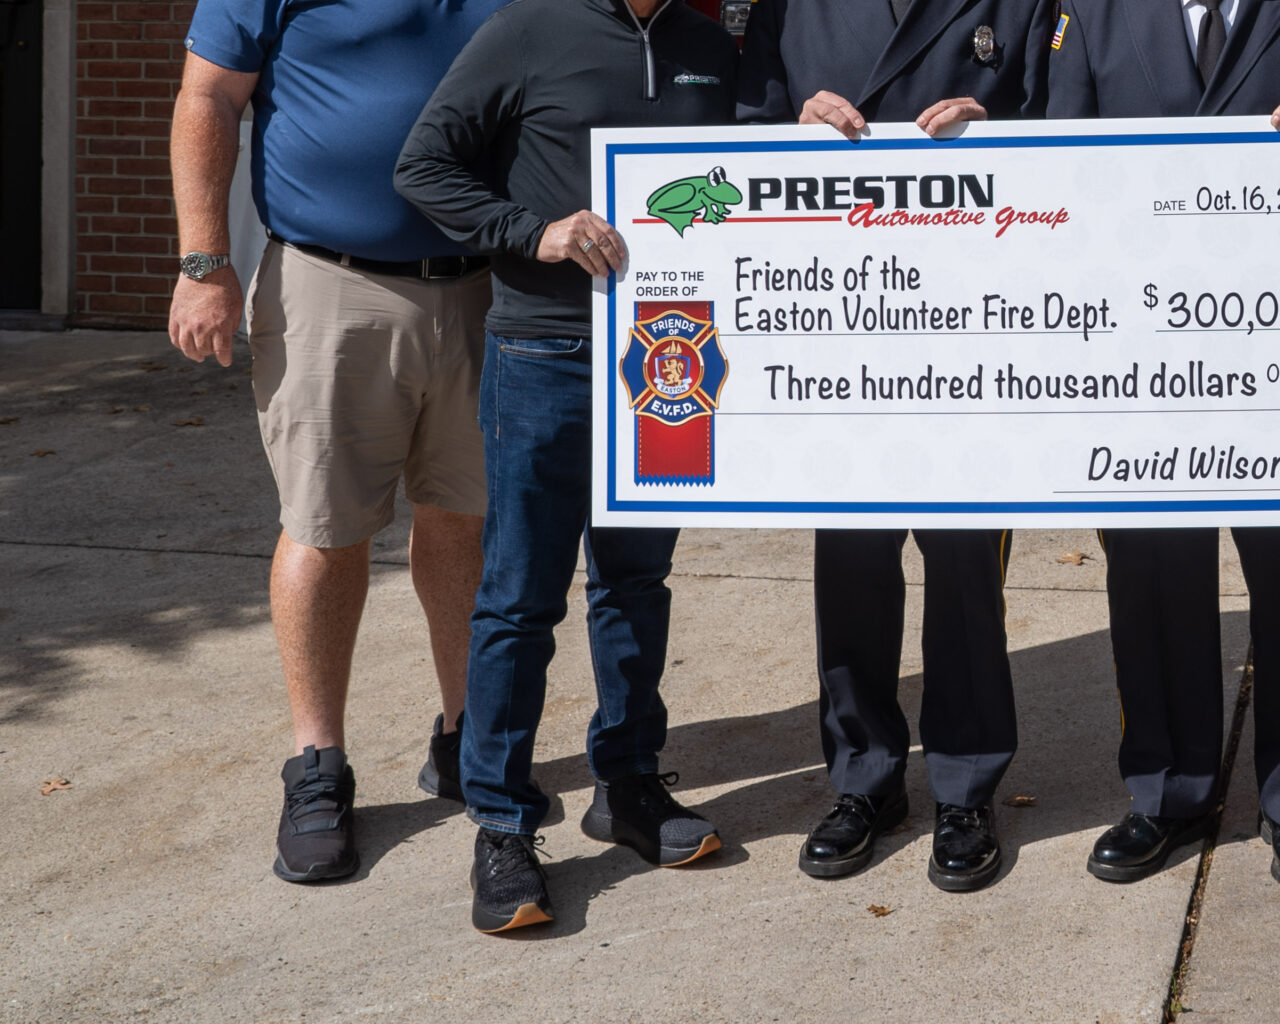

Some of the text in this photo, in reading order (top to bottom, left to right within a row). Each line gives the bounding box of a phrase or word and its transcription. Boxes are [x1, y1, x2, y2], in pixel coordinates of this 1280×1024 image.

[748, 174, 993, 211] PRESTON
[1153, 200, 1187, 212] DATE
[848, 202, 1070, 238] Automotive Group
[636, 271, 705, 282] PAY TO THE
[734, 255, 921, 292] Friends of the
[636, 286, 698, 297] ORDER OF
[651, 318, 696, 333] FRIENDS
[734, 292, 1118, 341] Easton Volunteer Fire Dept.
[668, 328, 679, 336] OF
[660, 385, 687, 394] EASTON
[764, 364, 851, 401] Three
[861, 364, 984, 401] hundred
[994, 362, 1139, 400] thousand
[1149, 360, 1257, 399] dollars
[650, 399, 698, 417] E.V.F.D.
[1087, 446, 1179, 482] David
